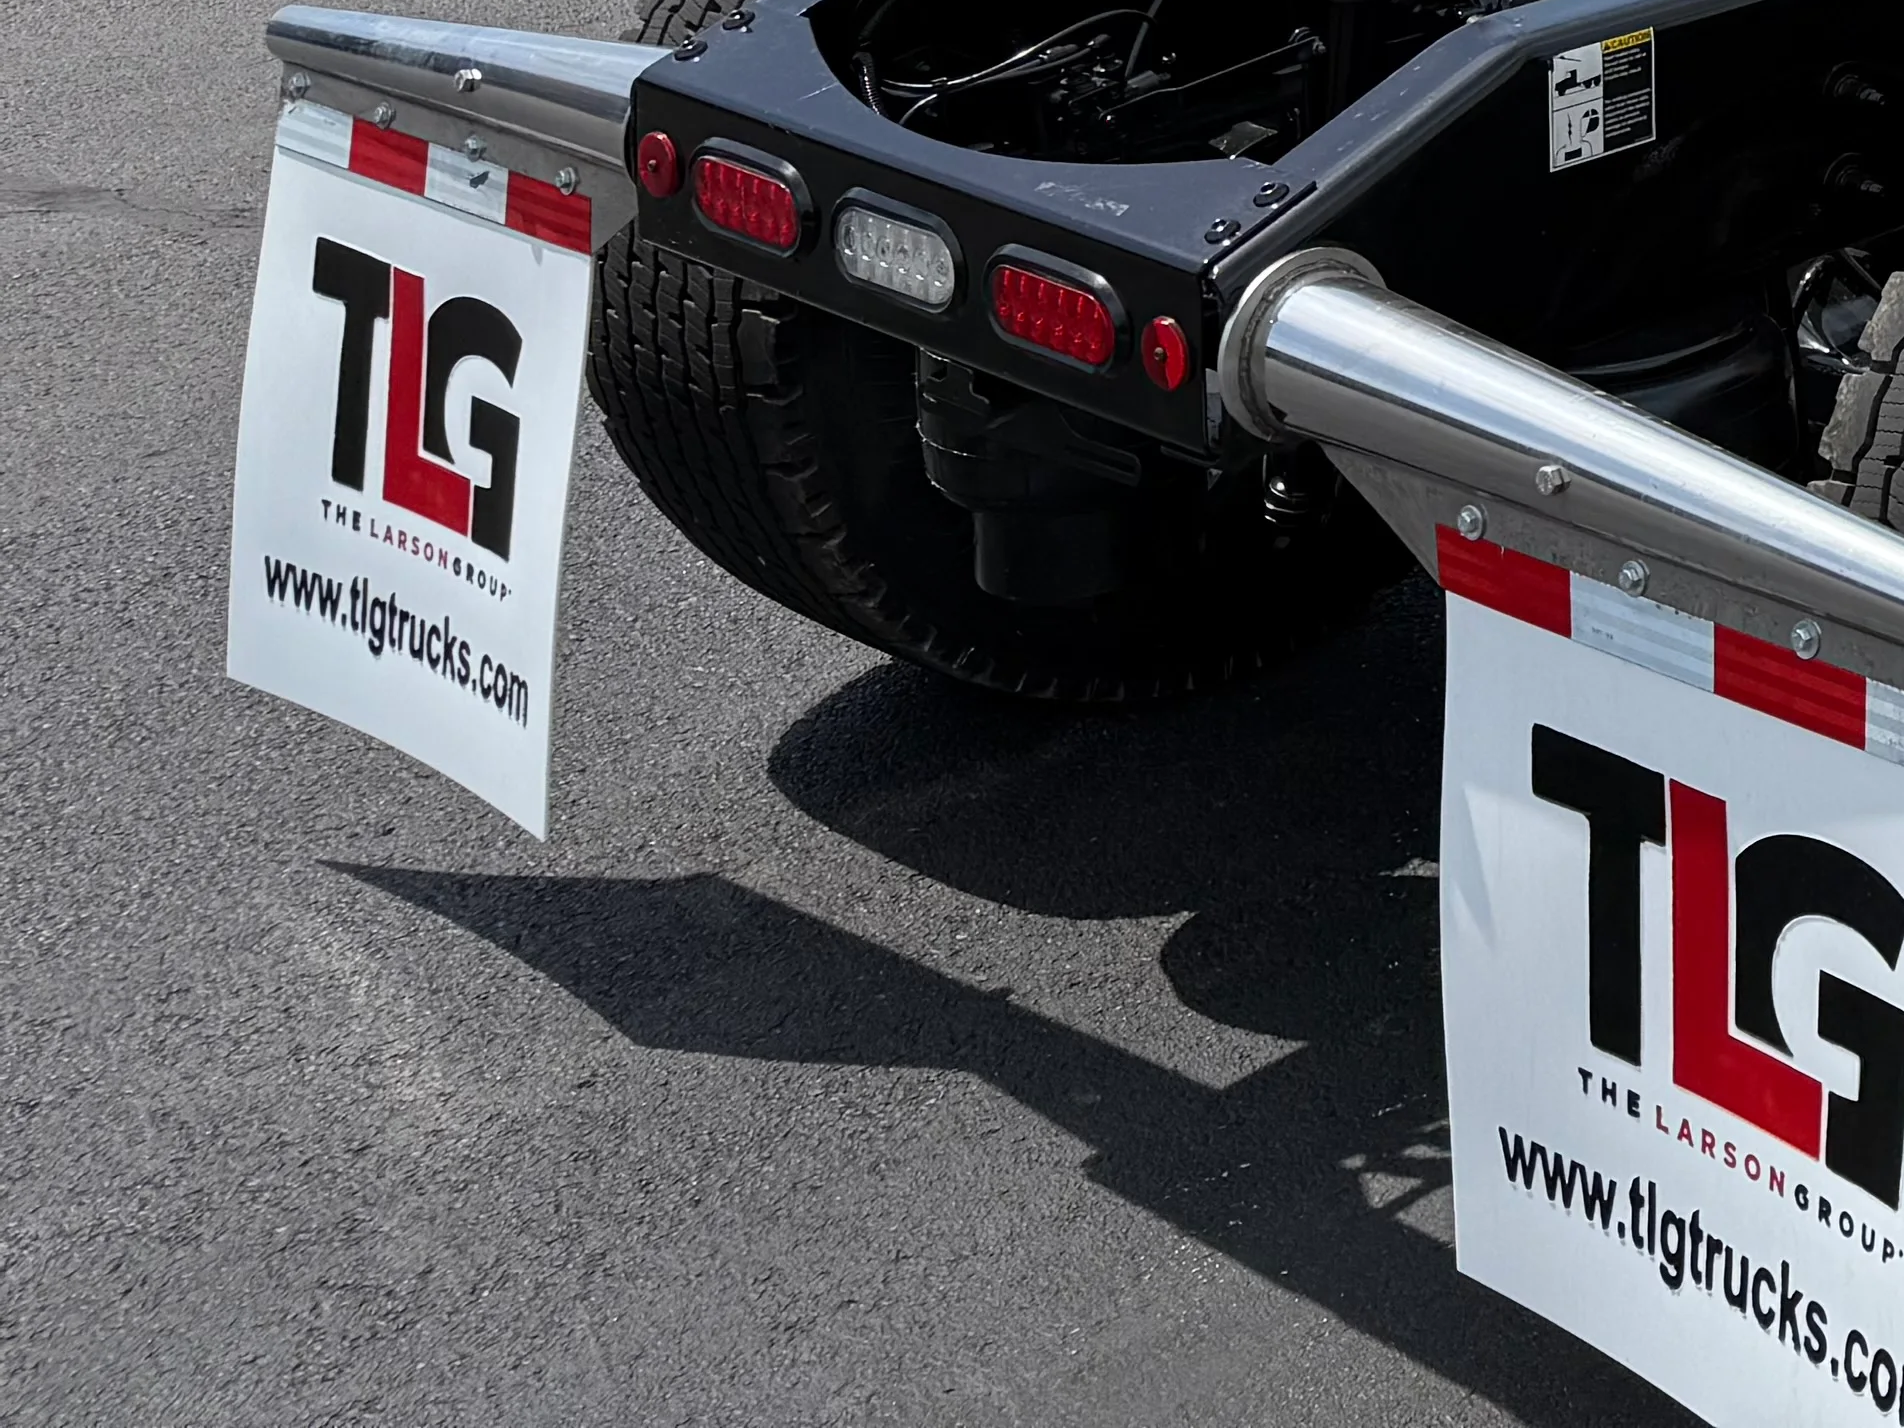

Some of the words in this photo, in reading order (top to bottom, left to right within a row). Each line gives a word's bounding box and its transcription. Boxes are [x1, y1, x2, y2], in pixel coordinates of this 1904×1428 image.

[312, 236, 523, 562] TLG
[264, 555, 530, 730] www.tlgtrucks.com
[321, 499, 362, 532] THE
[370, 518, 448, 569] LARSON
[453, 556, 507, 602] GROUP
[1577, 1067, 1642, 1119] THE
[1655, 1104, 1785, 1198] LARSON
[1794, 1183, 1896, 1263] GROUP
